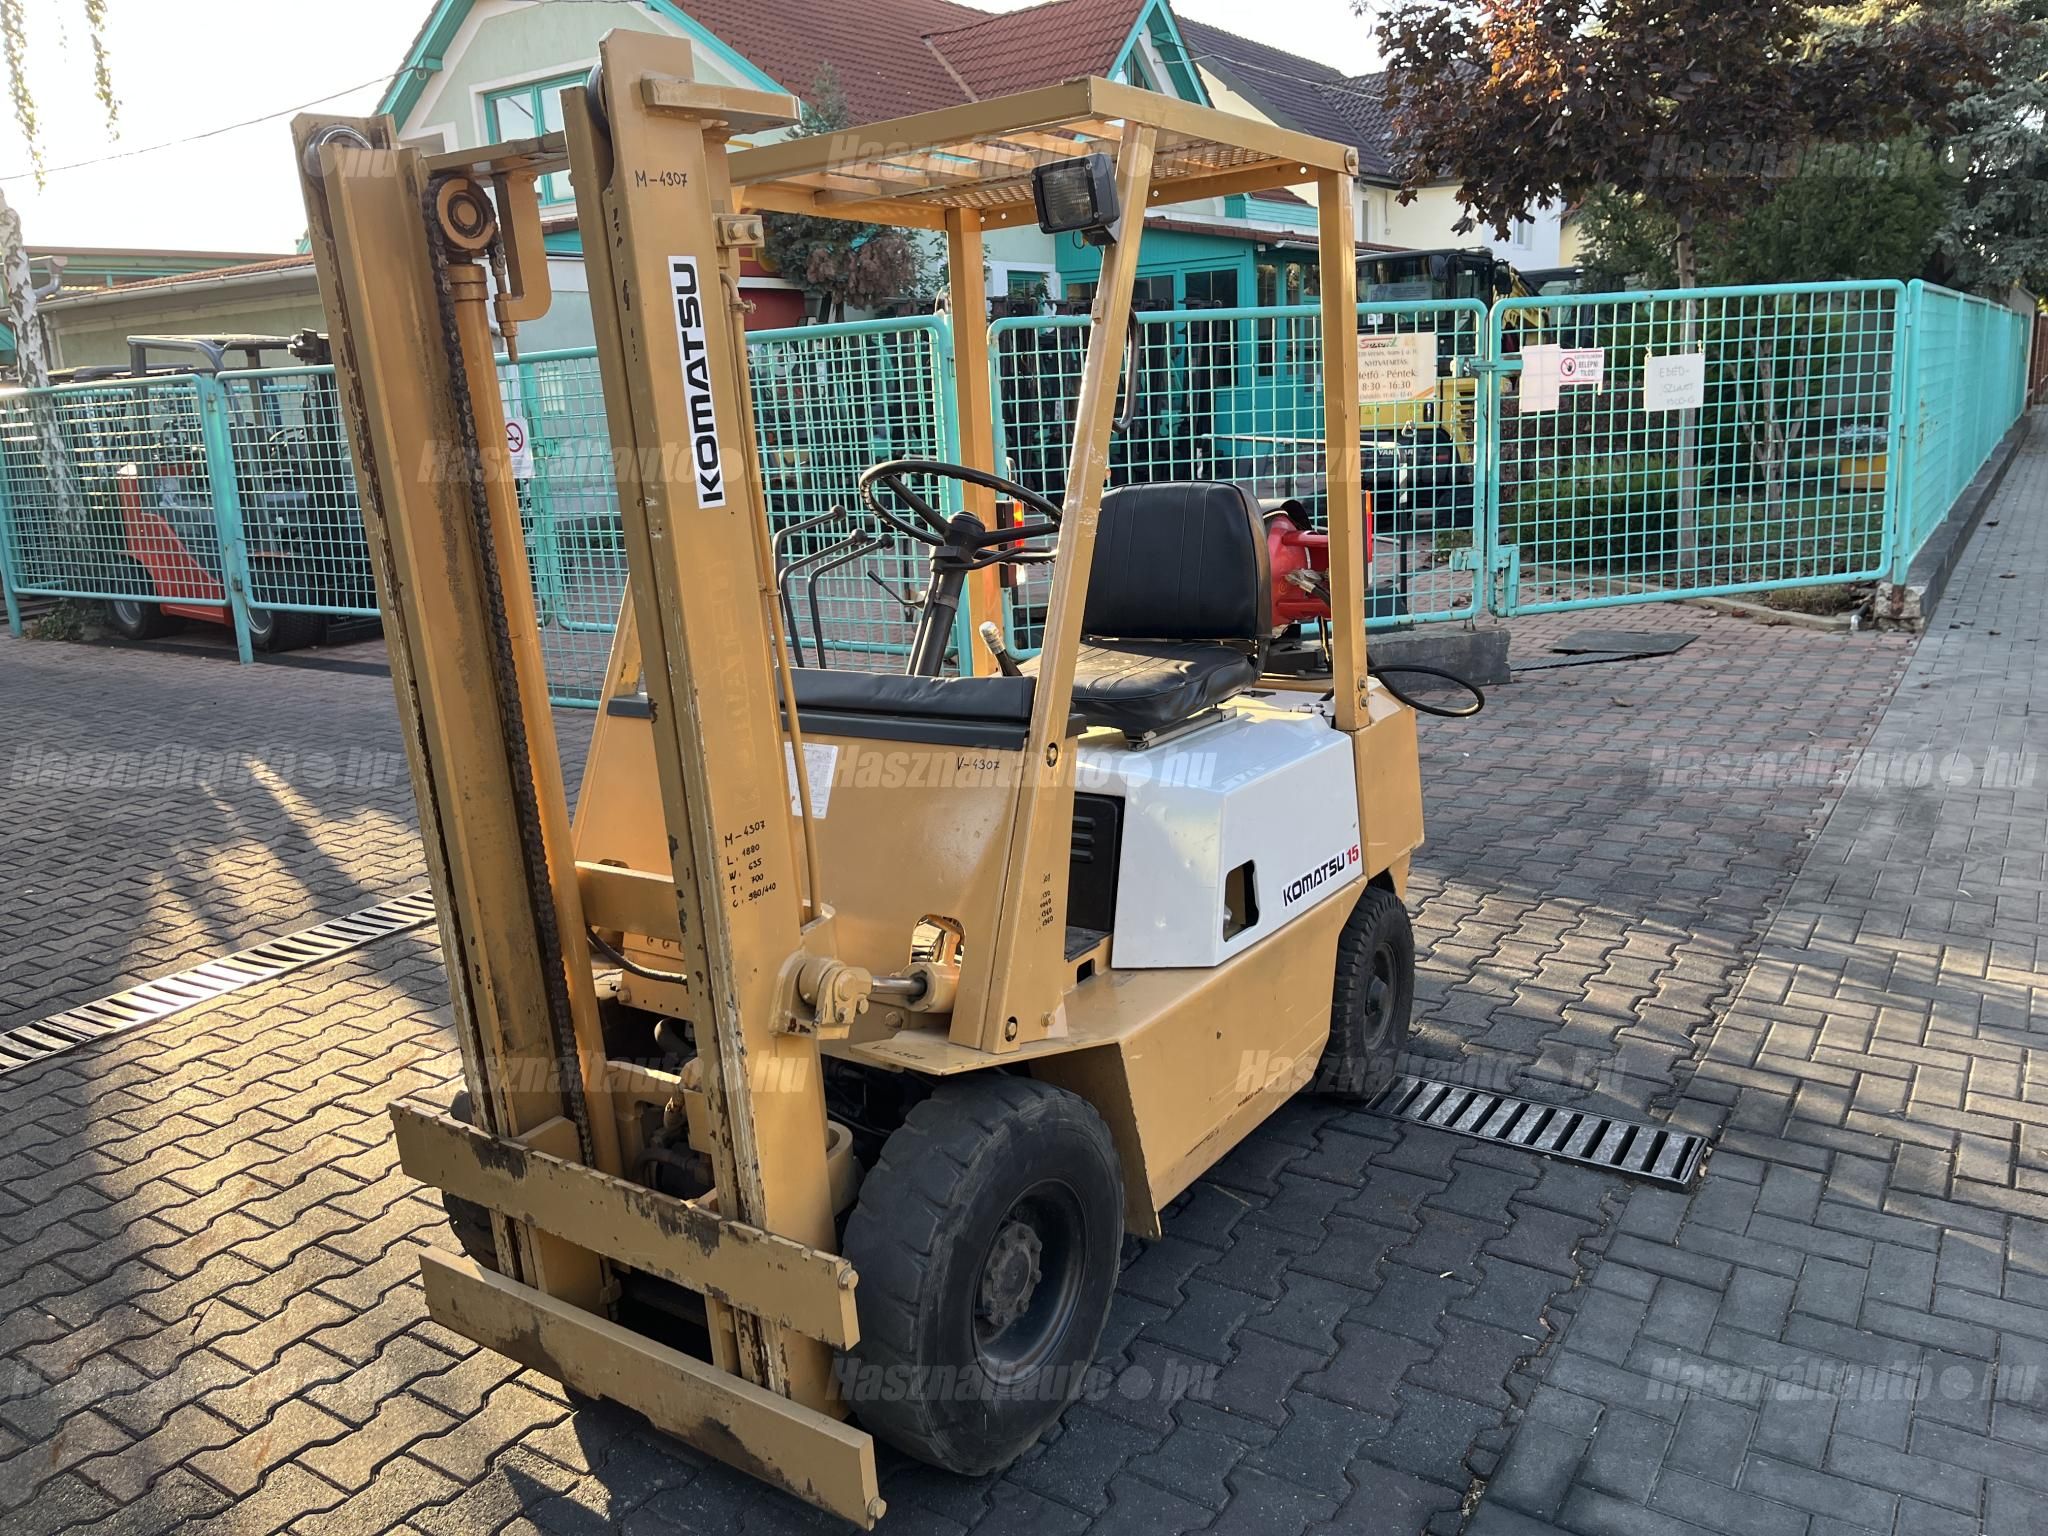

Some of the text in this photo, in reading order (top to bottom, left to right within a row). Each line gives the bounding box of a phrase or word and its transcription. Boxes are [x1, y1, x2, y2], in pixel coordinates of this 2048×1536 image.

[673, 262, 723, 503] KOMATSU
[1283, 844, 1359, 907] KOMATSU 15
